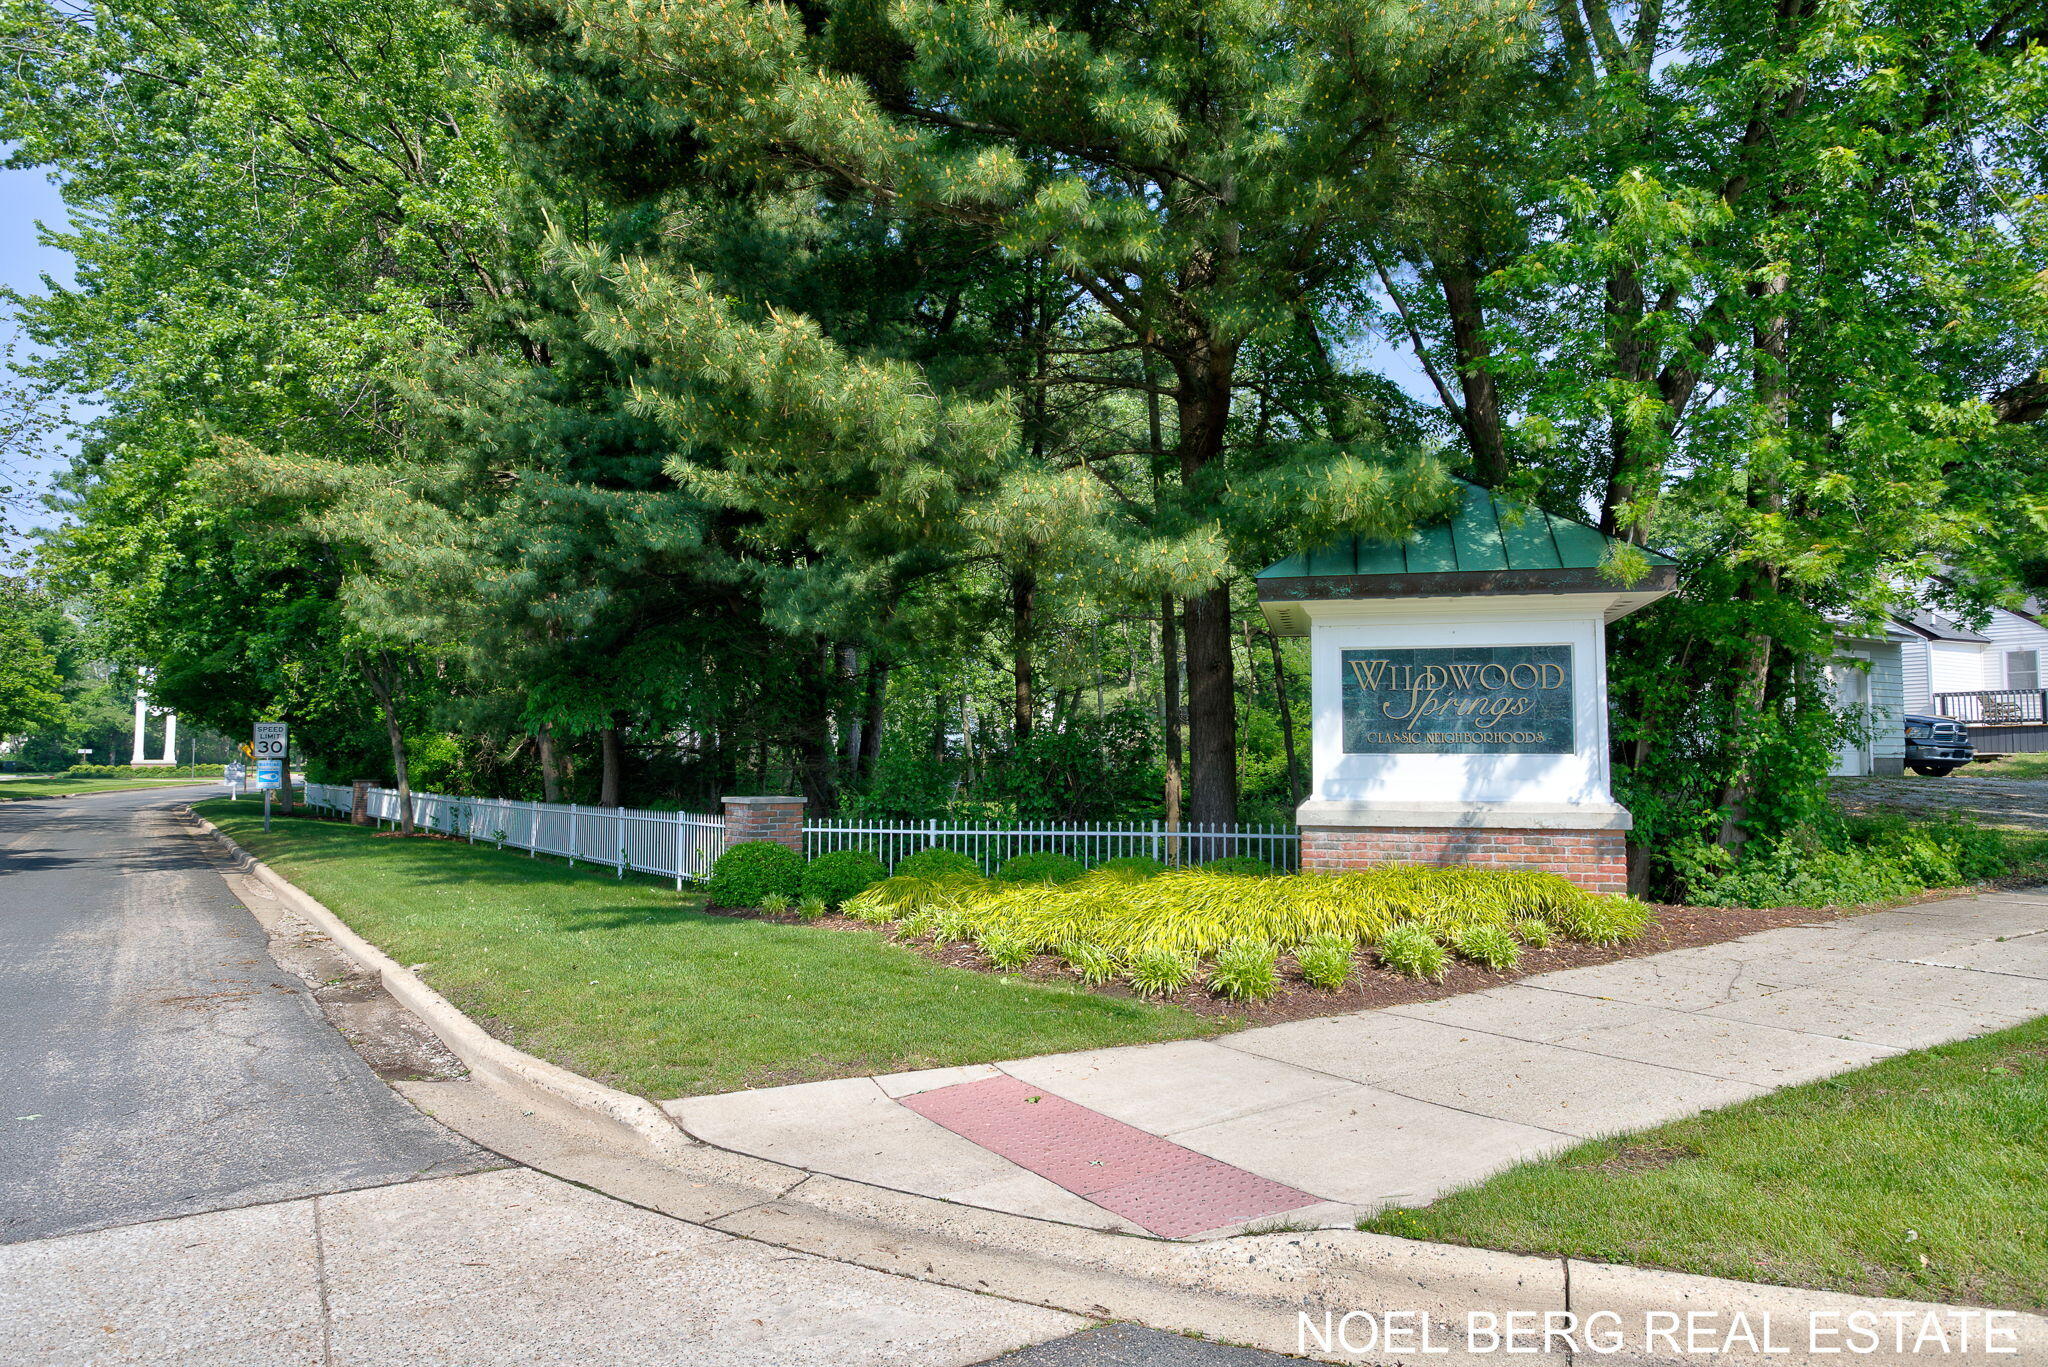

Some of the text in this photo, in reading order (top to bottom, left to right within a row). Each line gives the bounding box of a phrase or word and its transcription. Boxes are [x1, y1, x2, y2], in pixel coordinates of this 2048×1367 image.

[1347, 660, 1566, 691] WILDWOOD
[1382, 672, 1537, 731] Springs
[258, 741, 283, 754] 30
[1367, 731, 1545, 745] CLASSIC NEIGHBORHOODS
